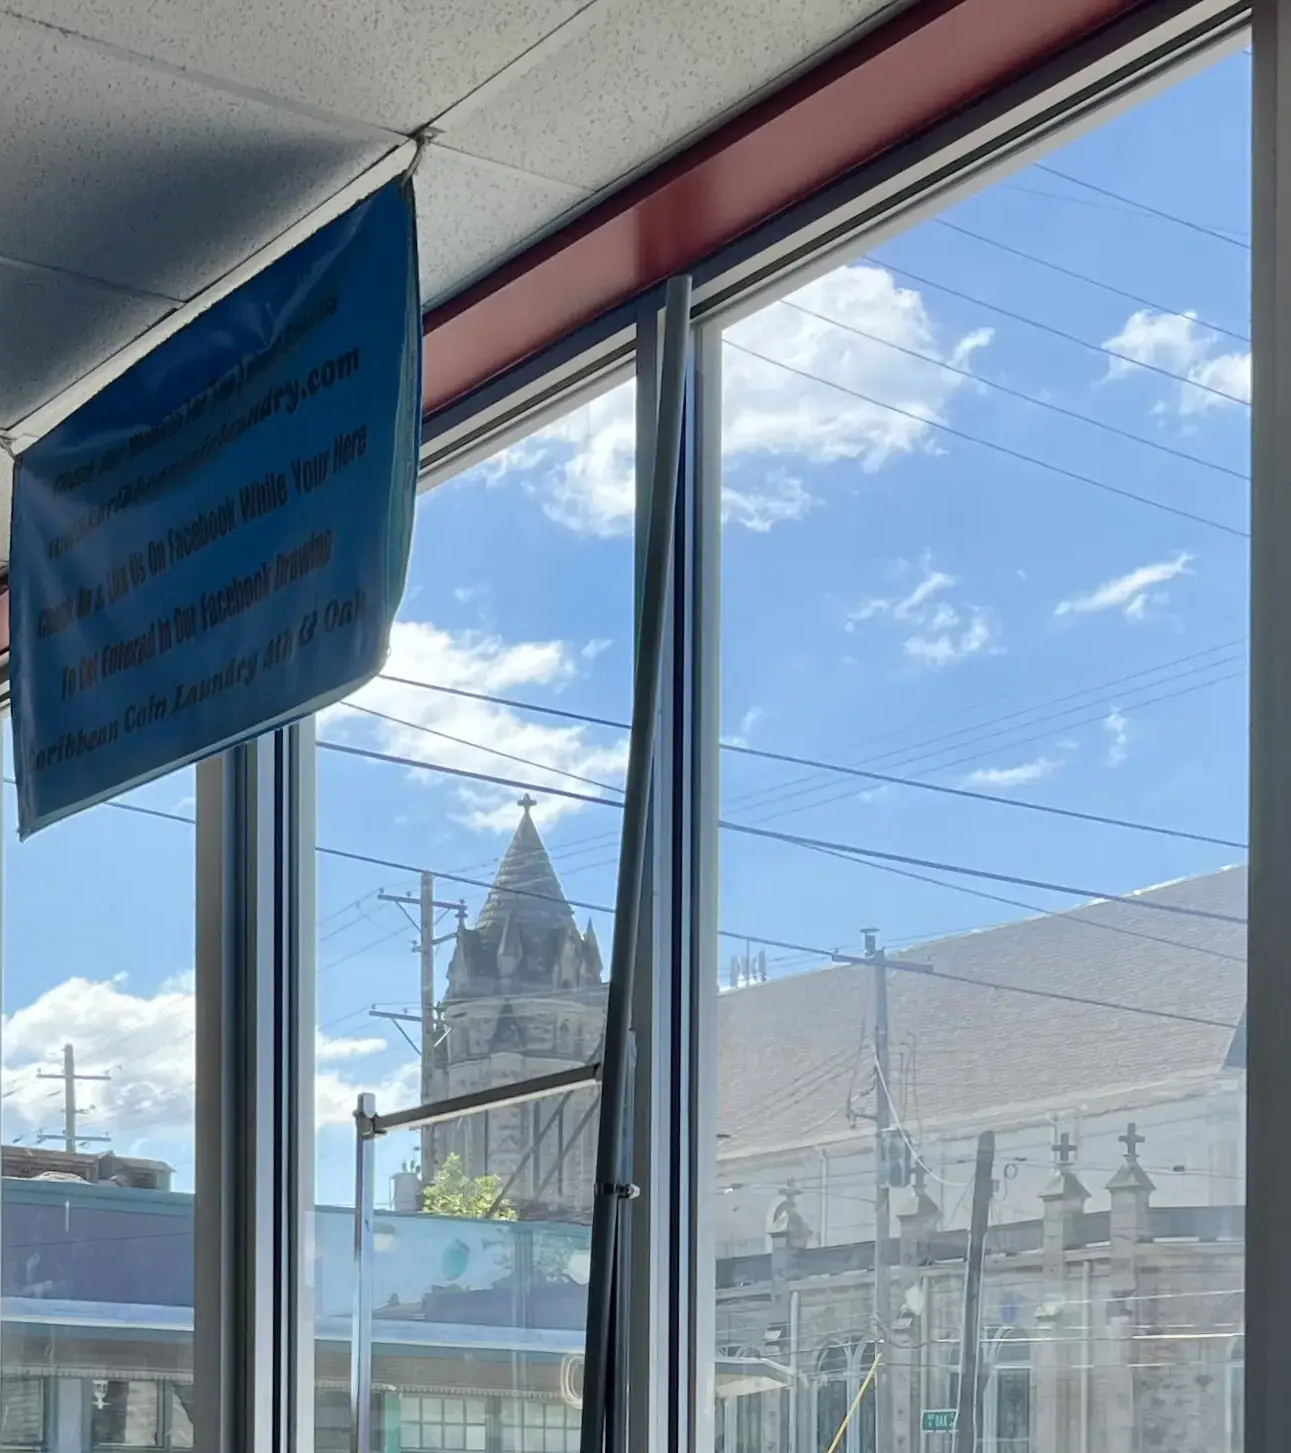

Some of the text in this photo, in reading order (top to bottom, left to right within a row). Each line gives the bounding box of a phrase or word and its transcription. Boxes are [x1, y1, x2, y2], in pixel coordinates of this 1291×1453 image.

[148, 540, 166, 576] On
[167, 496, 236, 566] Facebook
[239, 471, 288, 522] While
[291, 449, 330, 498] Your
[332, 423, 368, 475] Here
[200, 562, 271, 632] Facebook
[273, 528, 333, 592] Drawing
[31, 719, 119, 771] aribbean
[124, 694, 168, 735] Coin
[171, 653, 259, 714] Laundry
[263, 629, 292, 671] 4th
